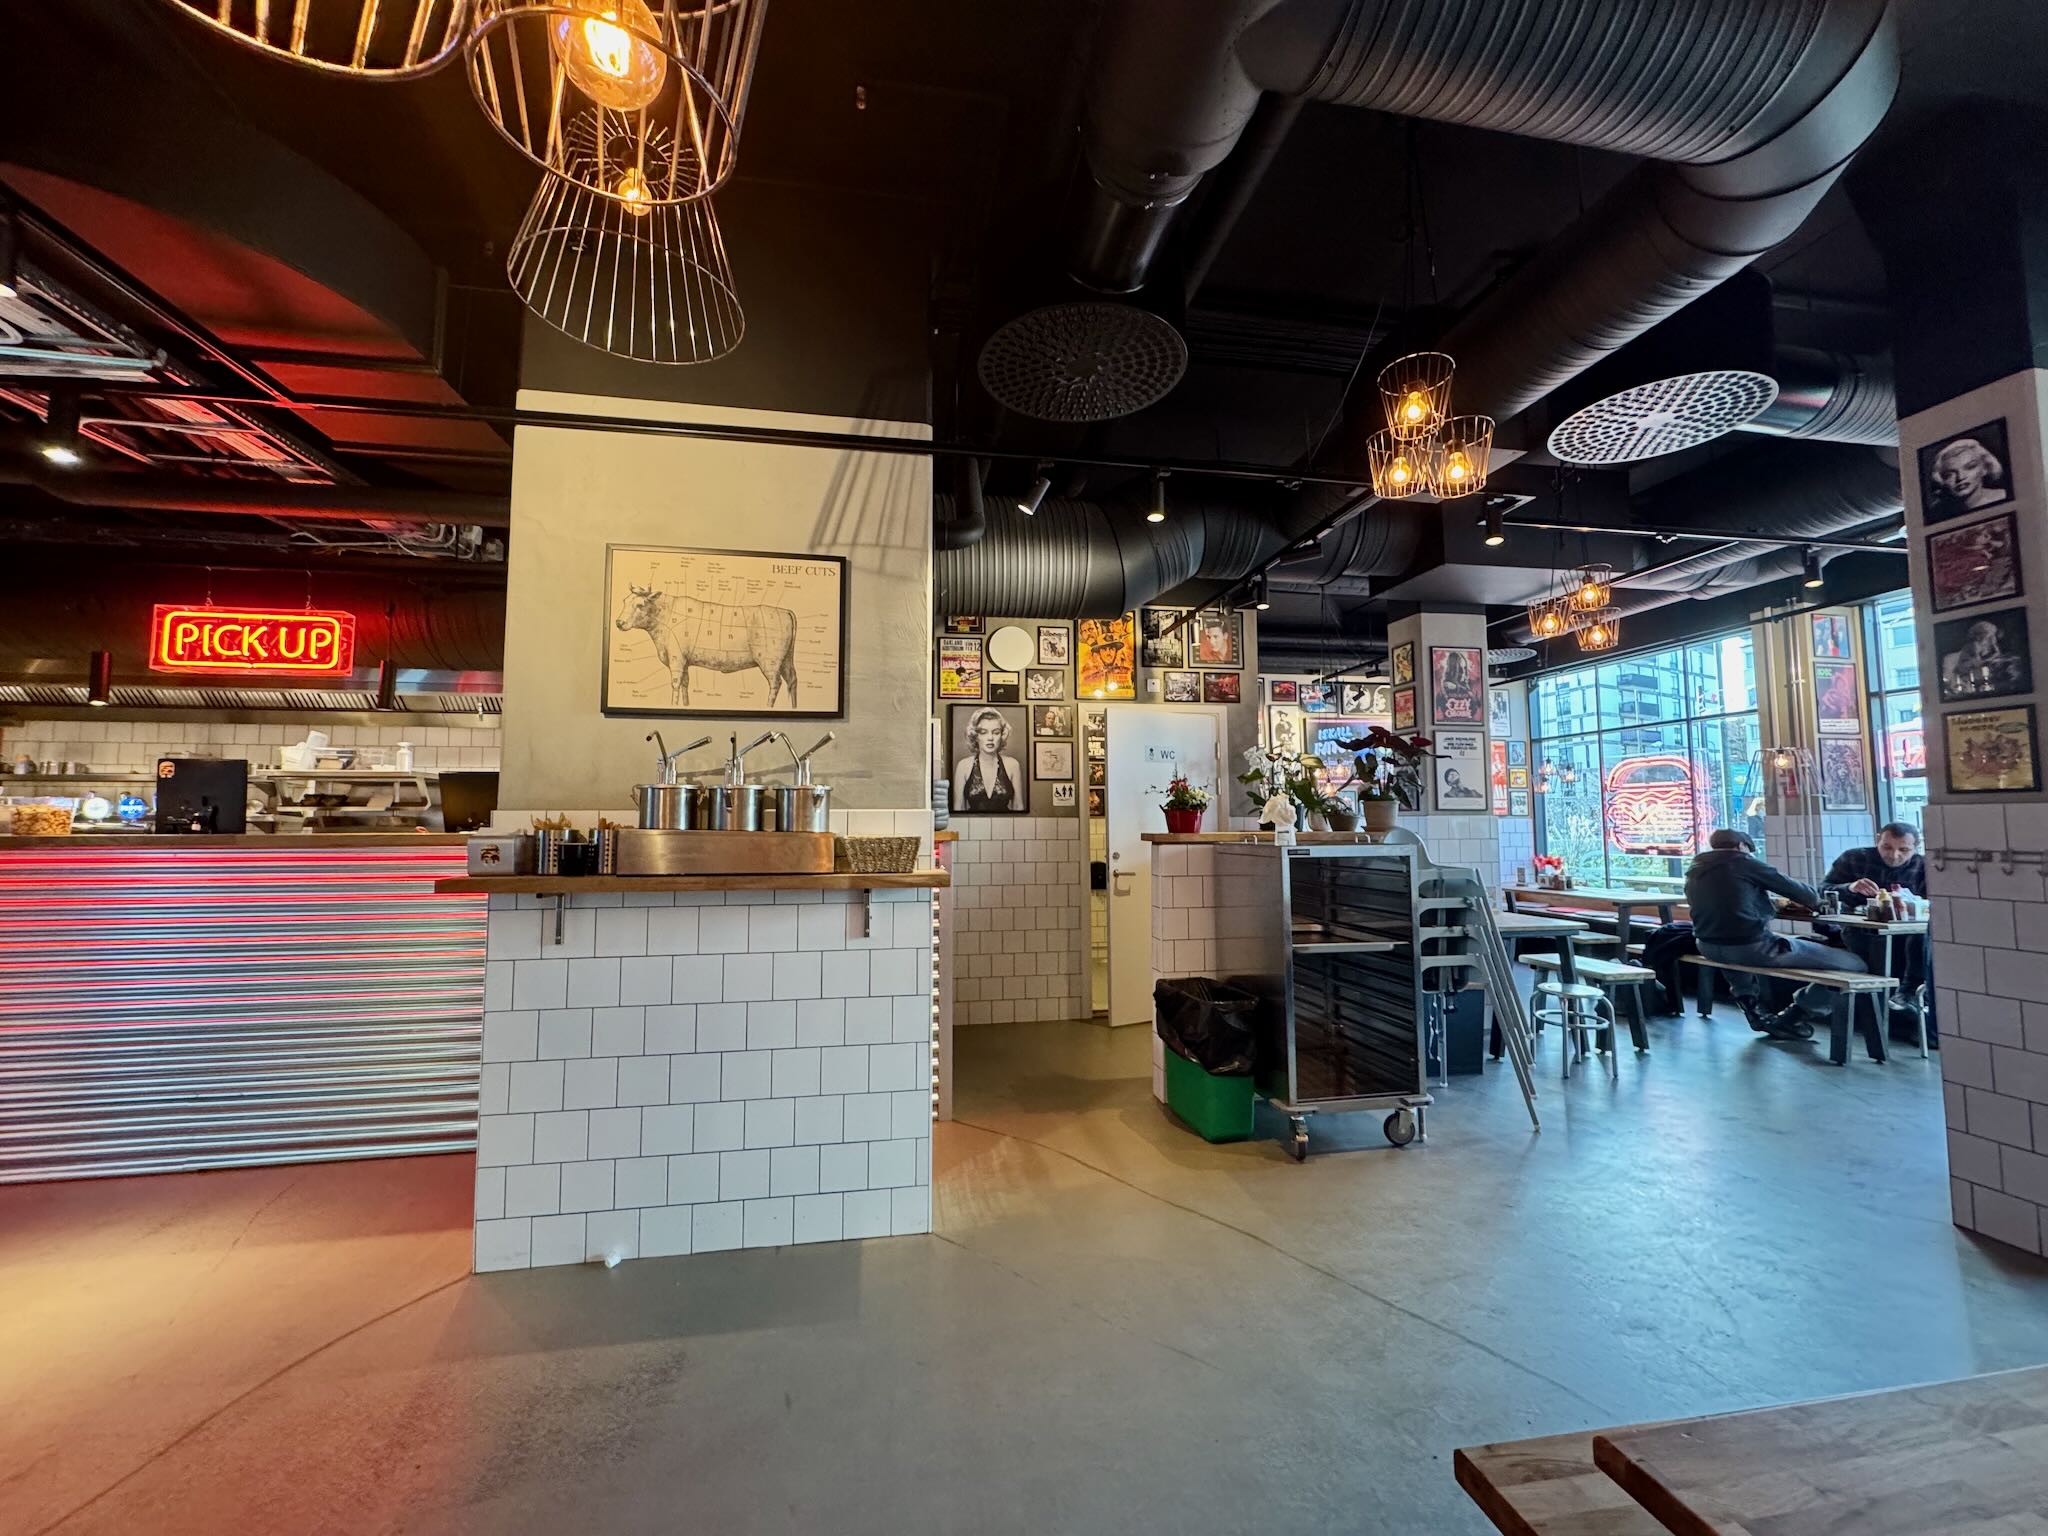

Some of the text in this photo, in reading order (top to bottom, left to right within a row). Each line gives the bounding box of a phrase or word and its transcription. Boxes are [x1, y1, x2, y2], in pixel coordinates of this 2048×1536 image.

[772, 564, 836, 576] BEEF CUTS
[175, 623, 333, 659] PICK UP
[1160, 750, 1176, 760] WC
